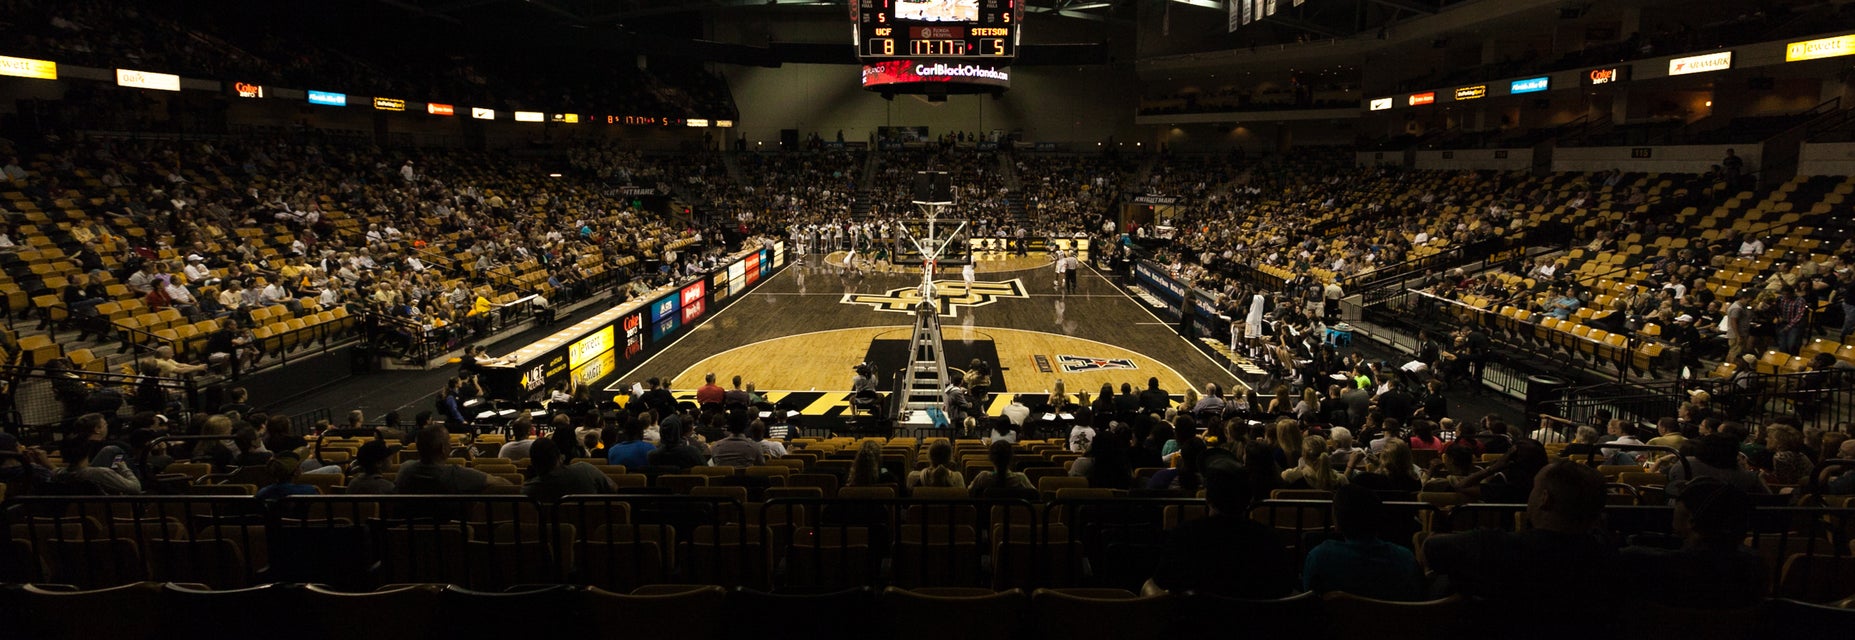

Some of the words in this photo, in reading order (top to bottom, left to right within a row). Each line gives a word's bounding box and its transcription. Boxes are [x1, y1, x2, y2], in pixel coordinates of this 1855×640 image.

[876, 28, 892, 36] UCF
[971, 28, 1008, 36] STETSON
[884, 39, 894, 54] 8
[994, 39, 1004, 54] 5
[1803, 40, 1841, 54] Jewett
[1690, 58, 1730, 69] ARAMARK
[916, 63, 1008, 80] CarlBlackOrlando.com
[1591, 70, 1612, 80] Coke
[236, 82, 257, 93] Coke
[624, 315, 639, 331] Coke
[627, 326, 638, 338] zero
[527, 363, 544, 384] UCF
